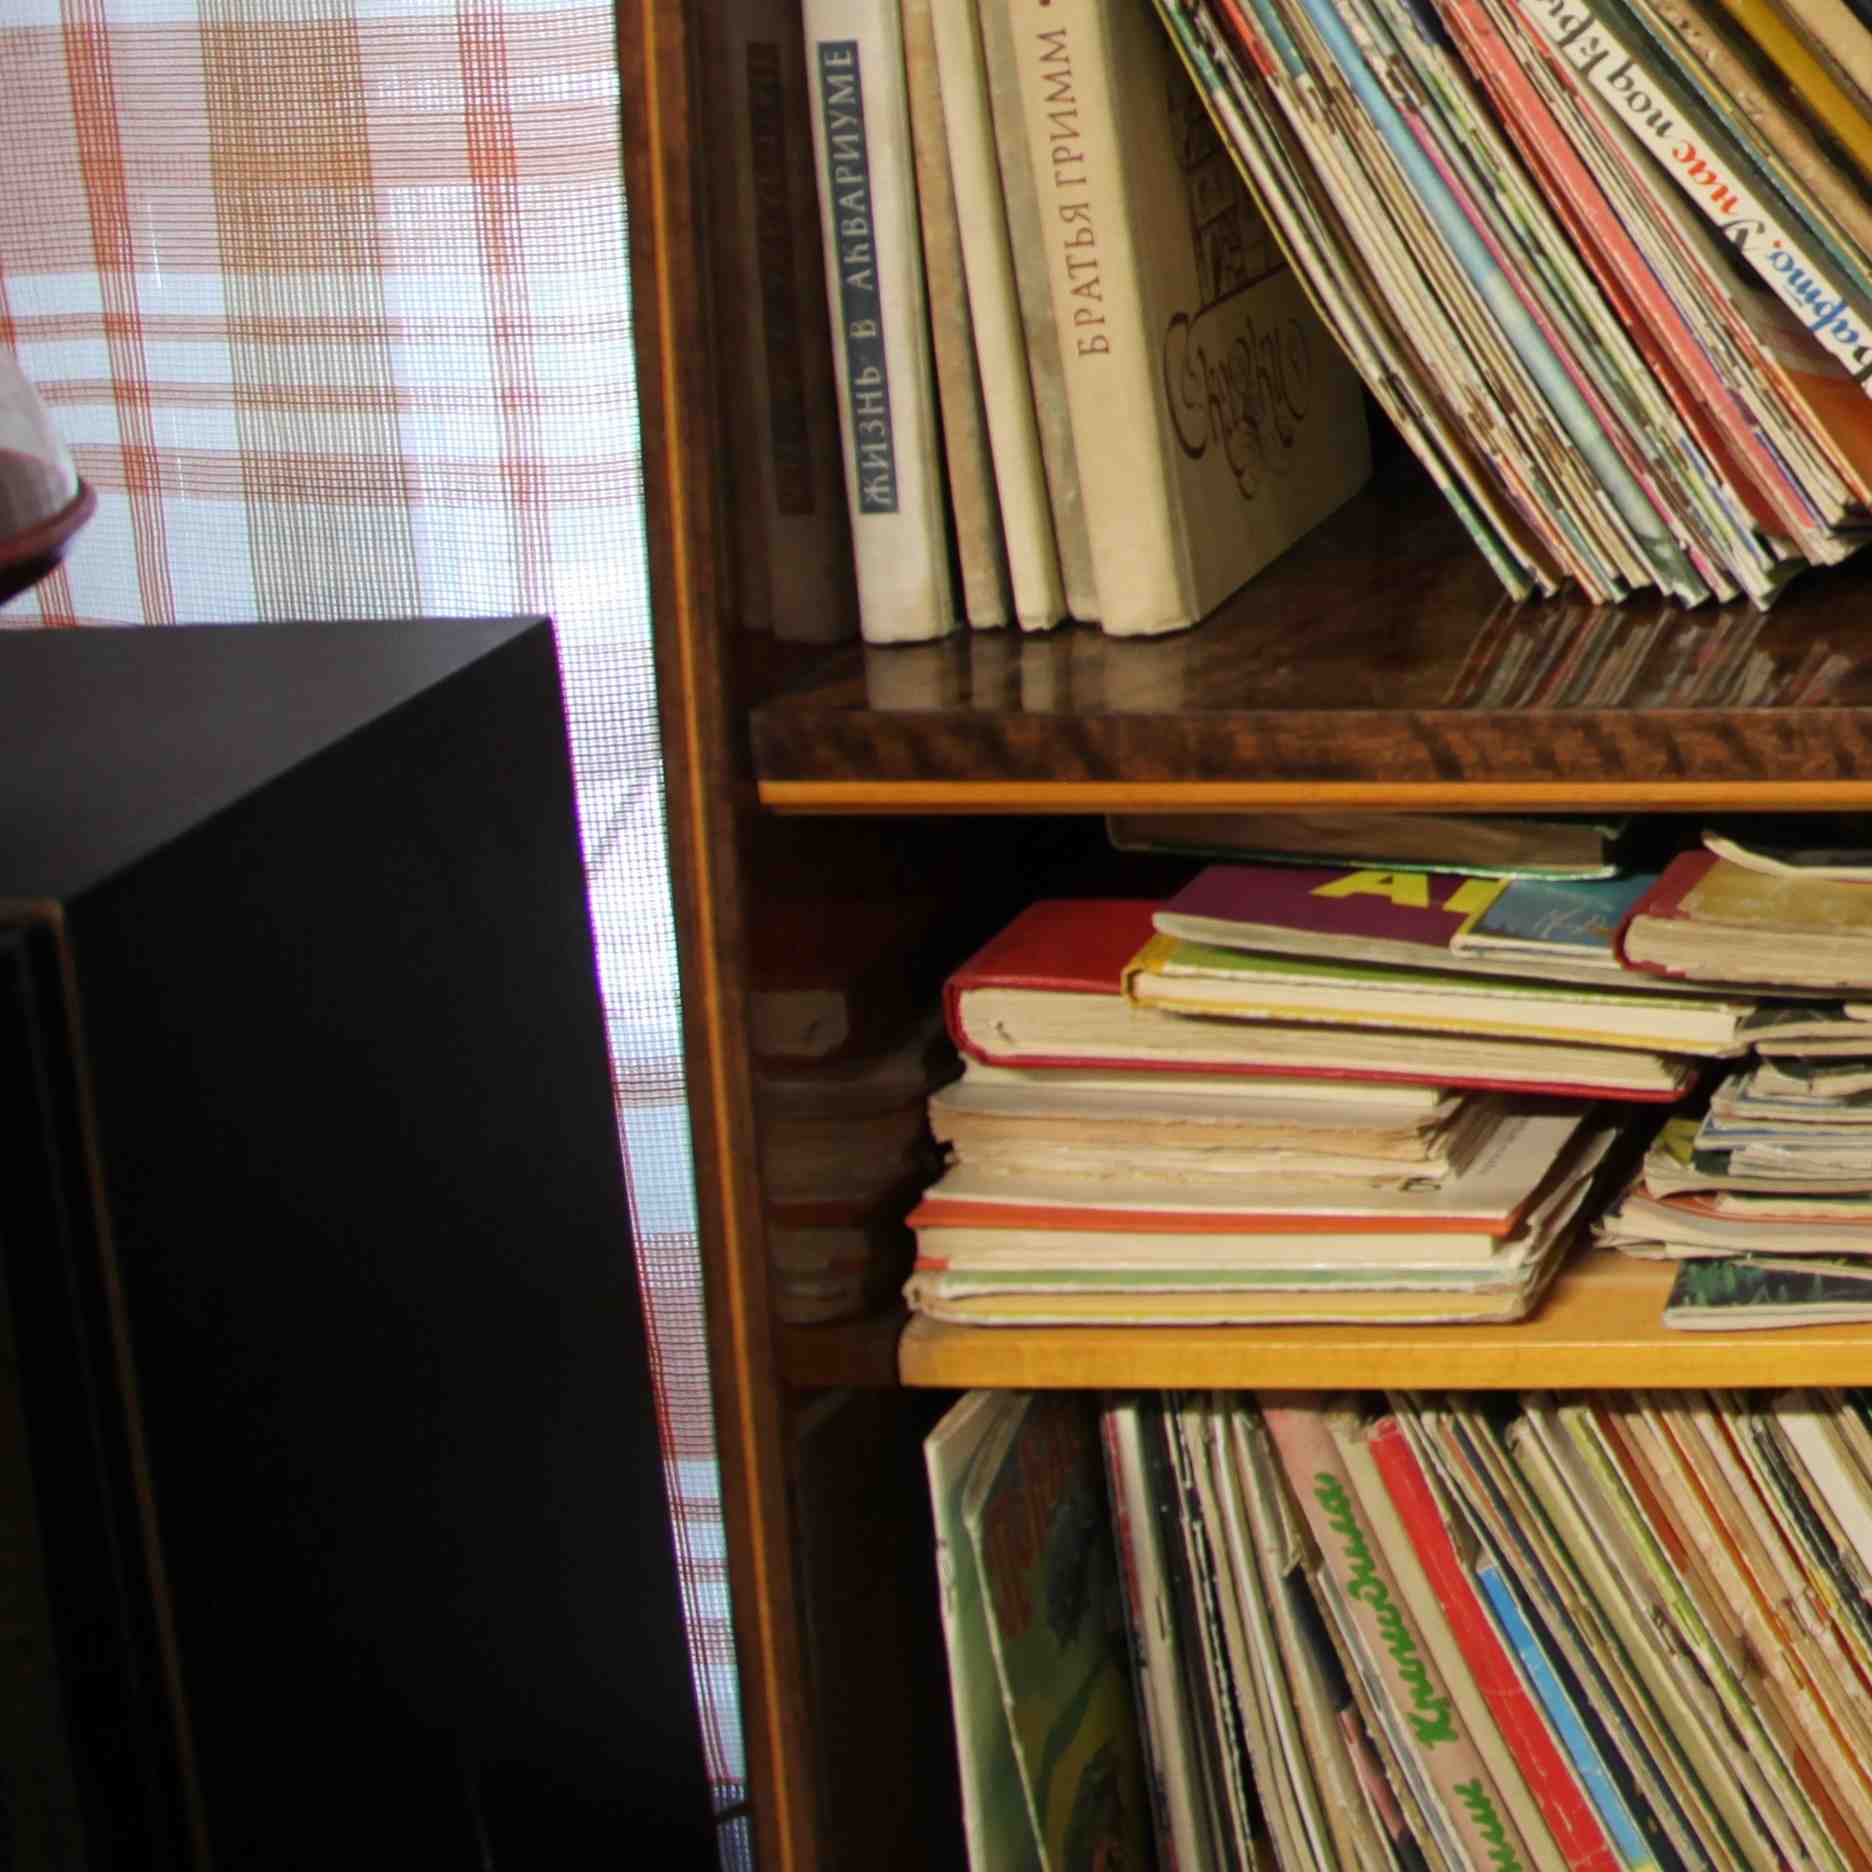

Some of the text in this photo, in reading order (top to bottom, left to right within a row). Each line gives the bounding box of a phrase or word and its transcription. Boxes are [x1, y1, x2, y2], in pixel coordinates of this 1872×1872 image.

[1041, 27, 1088, 188] ГРИММ
[1601, 56, 1683, 144] под
[1668, 136, 1742, 218] нас
[825, 46, 891, 506] ЖИЗНЬ В АКВАРИУМЕ
[1058, 203, 1112, 358] БРАТЬЯ
